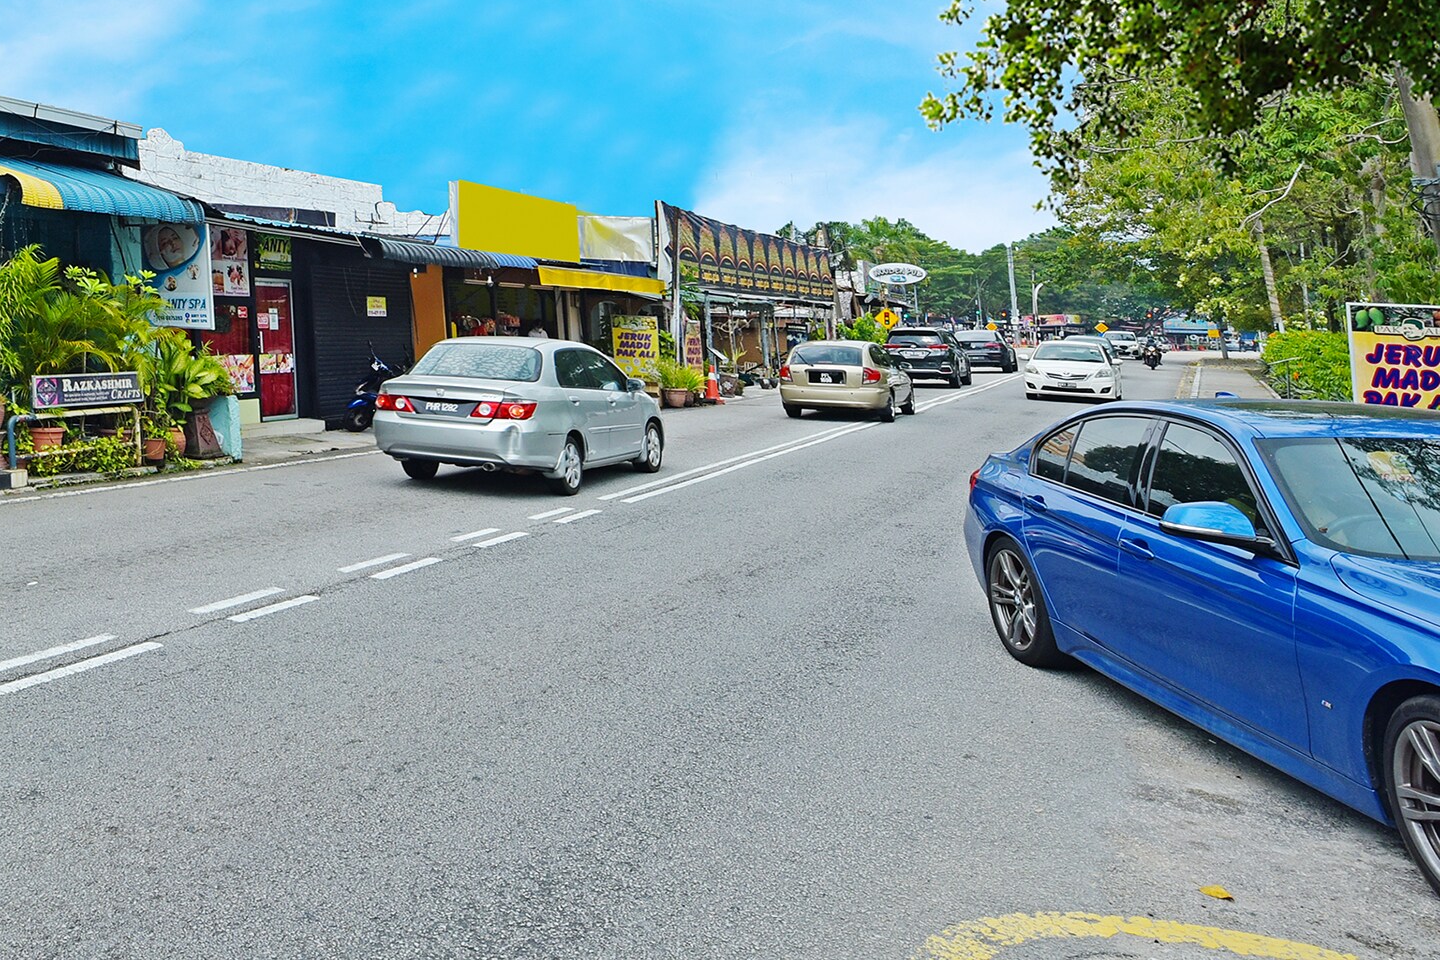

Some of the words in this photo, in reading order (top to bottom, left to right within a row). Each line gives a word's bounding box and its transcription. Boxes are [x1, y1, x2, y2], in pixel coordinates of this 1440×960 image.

[188, 298, 206, 309] SPA
[1376, 326, 1400, 334] PAK
[617, 332, 652, 342] JERUK
[619, 341, 651, 349] MADU
[616, 349, 637, 357] PAK
[638, 350, 656, 358] ALI
[62, 378, 133, 392] RAZKASHMIR
[110, 388, 141, 400] CRAFTS
[1363, 390, 1421, 407] PAK
